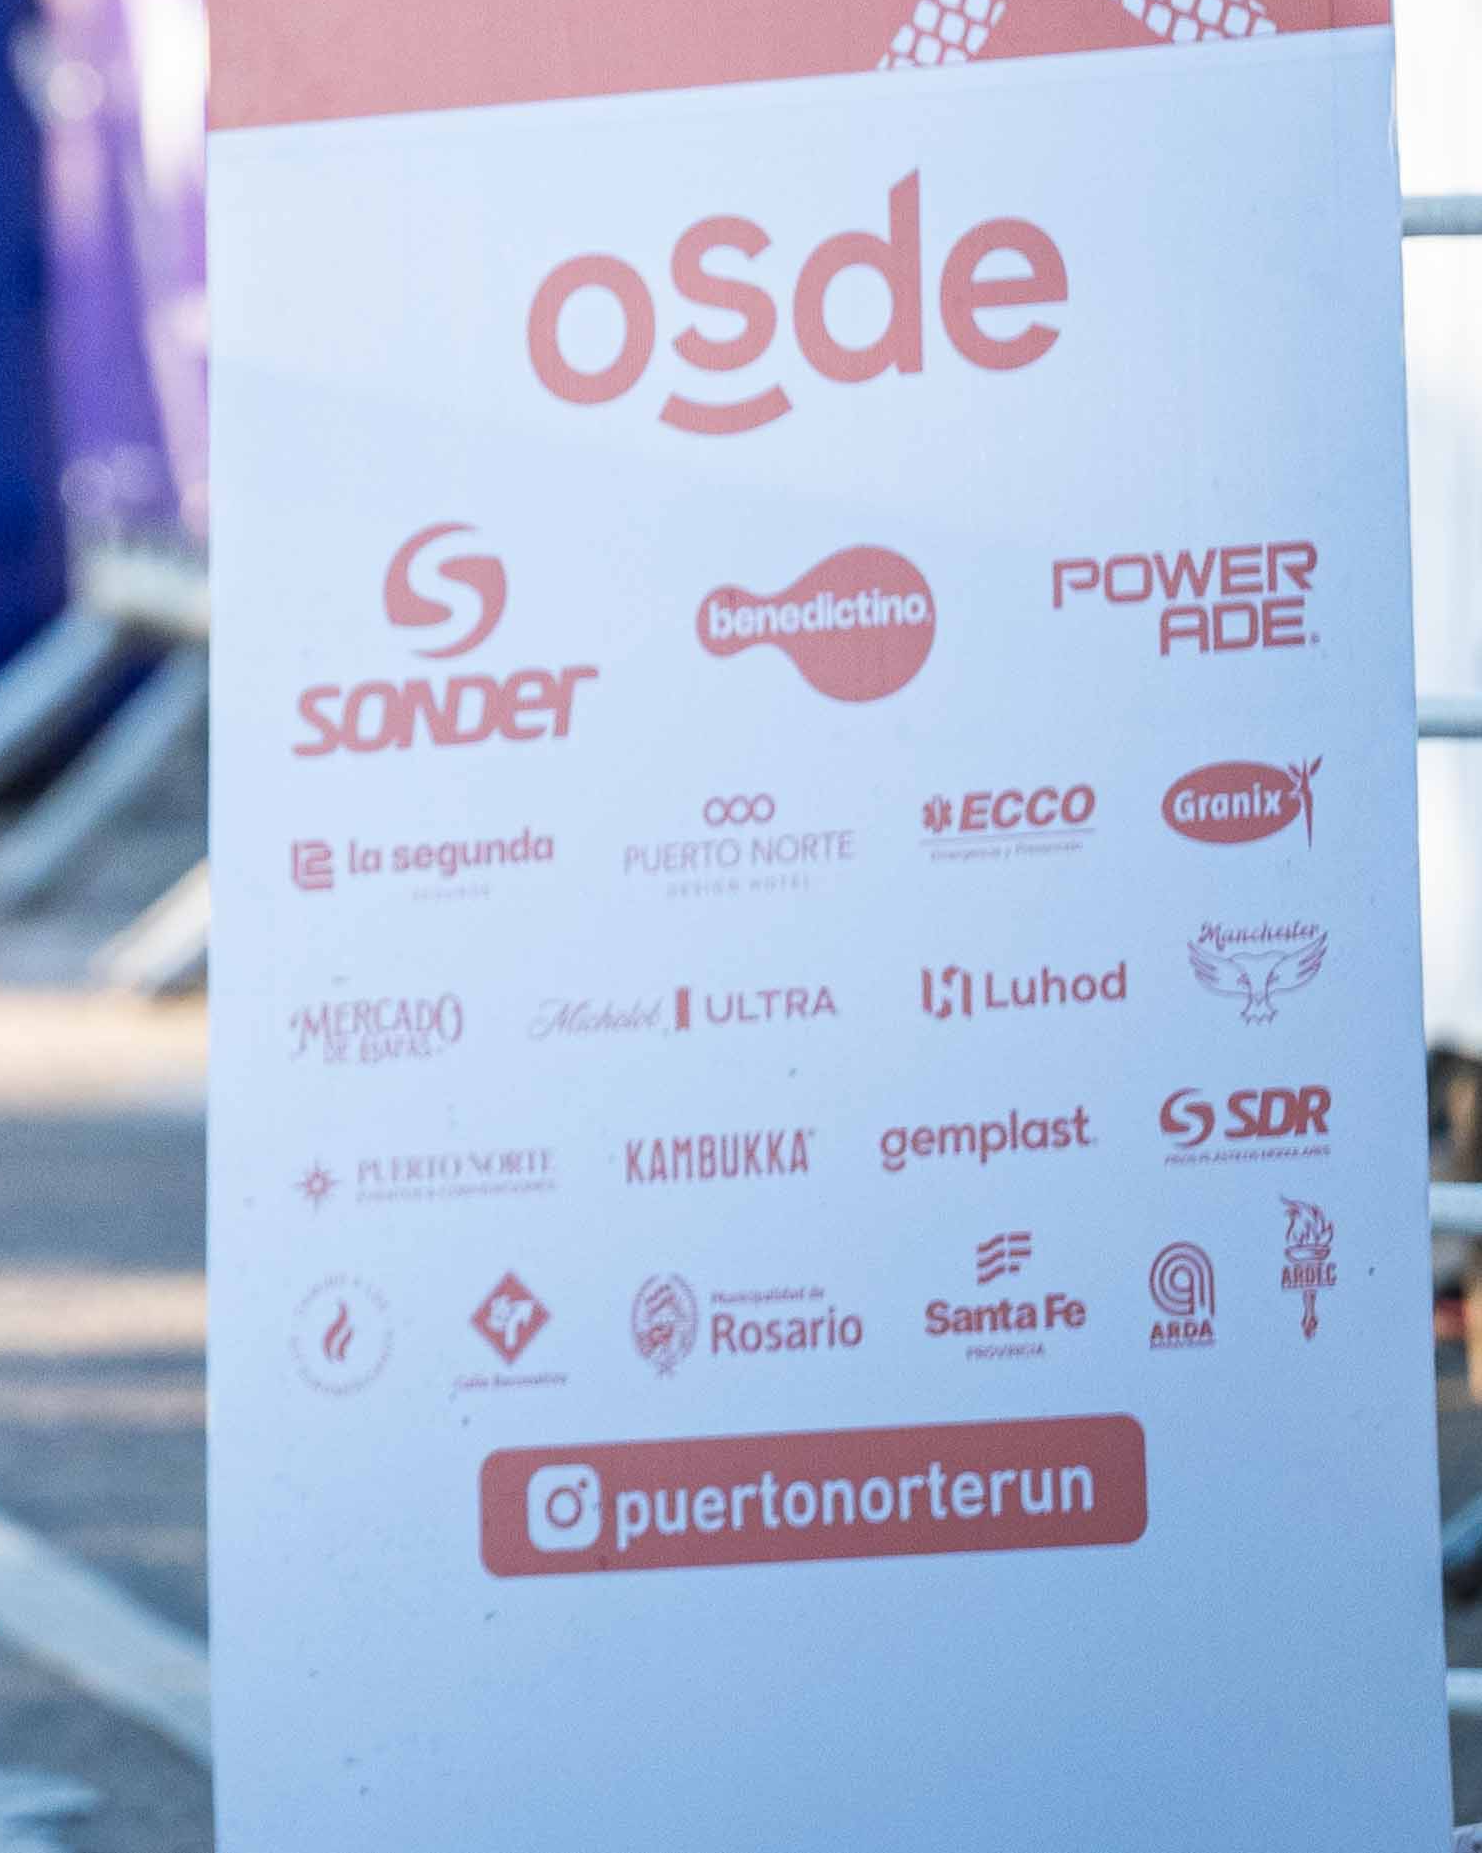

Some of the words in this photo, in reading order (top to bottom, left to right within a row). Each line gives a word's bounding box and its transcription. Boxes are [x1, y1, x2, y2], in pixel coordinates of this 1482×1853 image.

[527, 168, 1069, 408] osde
[1052, 541, 1318, 610] POWER
[708, 588, 928, 640] benedictino
[1159, 598, 1305, 656] ADE
[959, 784, 1096, 832] ECCO
[1173, 782, 1283, 823] Granix
[348, 839, 382, 875] la
[392, 826, 555, 878] segunda
[623, 837, 741, 876] PUERTO
[750, 829, 853, 866] NORTE
[706, 985, 836, 1024] ULTRA
[985, 961, 1127, 1009] Luhod
[1225, 1085, 1332, 1137] SDR
[626, 1130, 810, 1184] KAMBUKKA
[879, 1106, 1091, 1172] gemplast
[710, 1306, 864, 1355] Rosario
[925, 1299, 1038, 1336] Santa
[1044, 1293, 1086, 1329] Fe
[1151, 1320, 1213, 1338] ARDA
[615, 1460, 1095, 1550] puertonorterun
